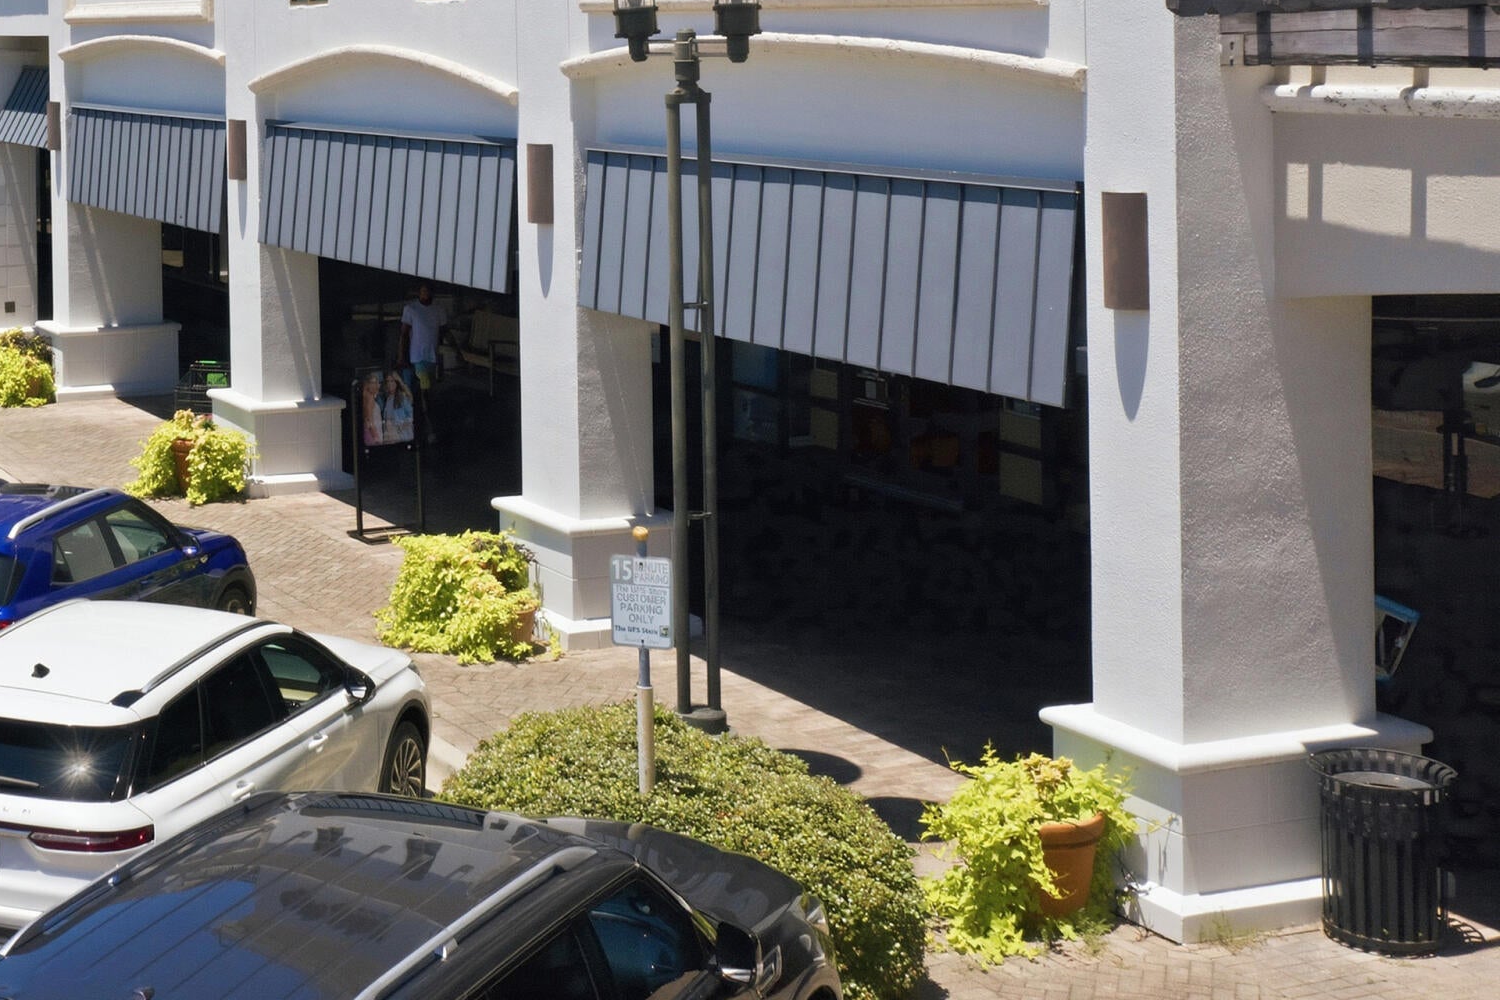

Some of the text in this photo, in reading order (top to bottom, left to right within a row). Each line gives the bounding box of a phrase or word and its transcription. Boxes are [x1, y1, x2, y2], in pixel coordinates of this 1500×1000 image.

[612, 559, 632, 580] 15
[616, 592, 667, 606] CUSTOMER
[620, 602, 663, 616] PARKING
[628, 613, 654, 625] ONLY
